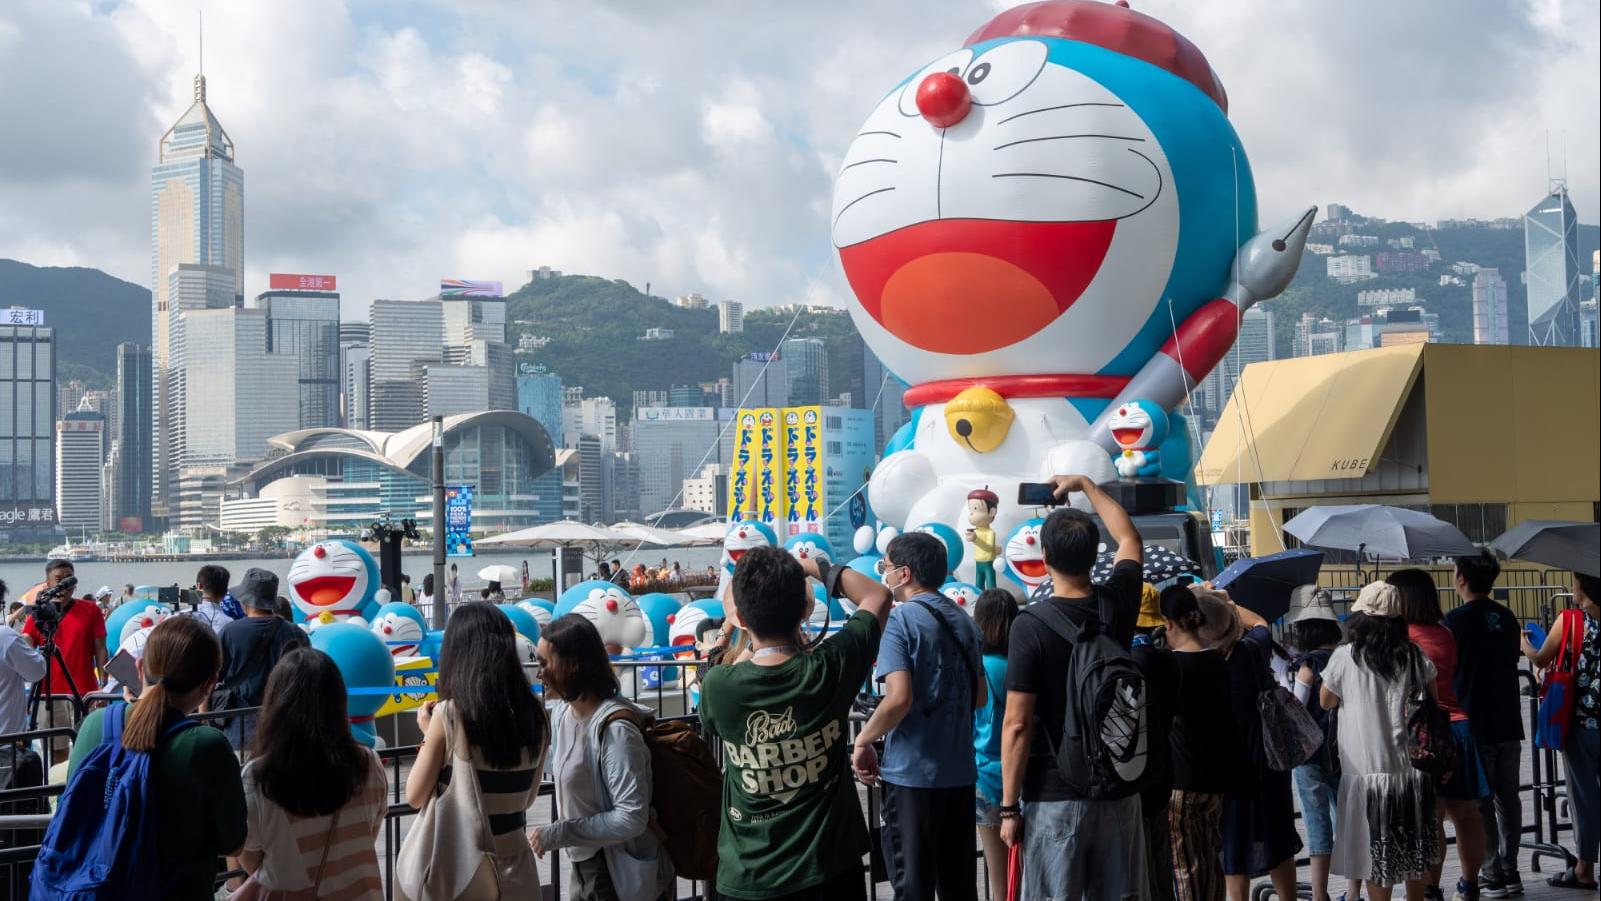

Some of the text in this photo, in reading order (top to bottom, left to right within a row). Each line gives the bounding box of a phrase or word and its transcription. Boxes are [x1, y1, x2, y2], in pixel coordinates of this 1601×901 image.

[10, 310, 39, 325] 宏利
[731, 428, 754, 523] ドラえもん
[761, 427, 775, 523] ドラえもん
[787, 427, 801, 522] ドラえもん
[804, 425, 819, 522] ドラえもん
[1331, 458, 1369, 471] KUBE
[723, 719, 841, 769] BARBER
[745, 705, 798, 748] Bad
[741, 754, 828, 794] SHOP
